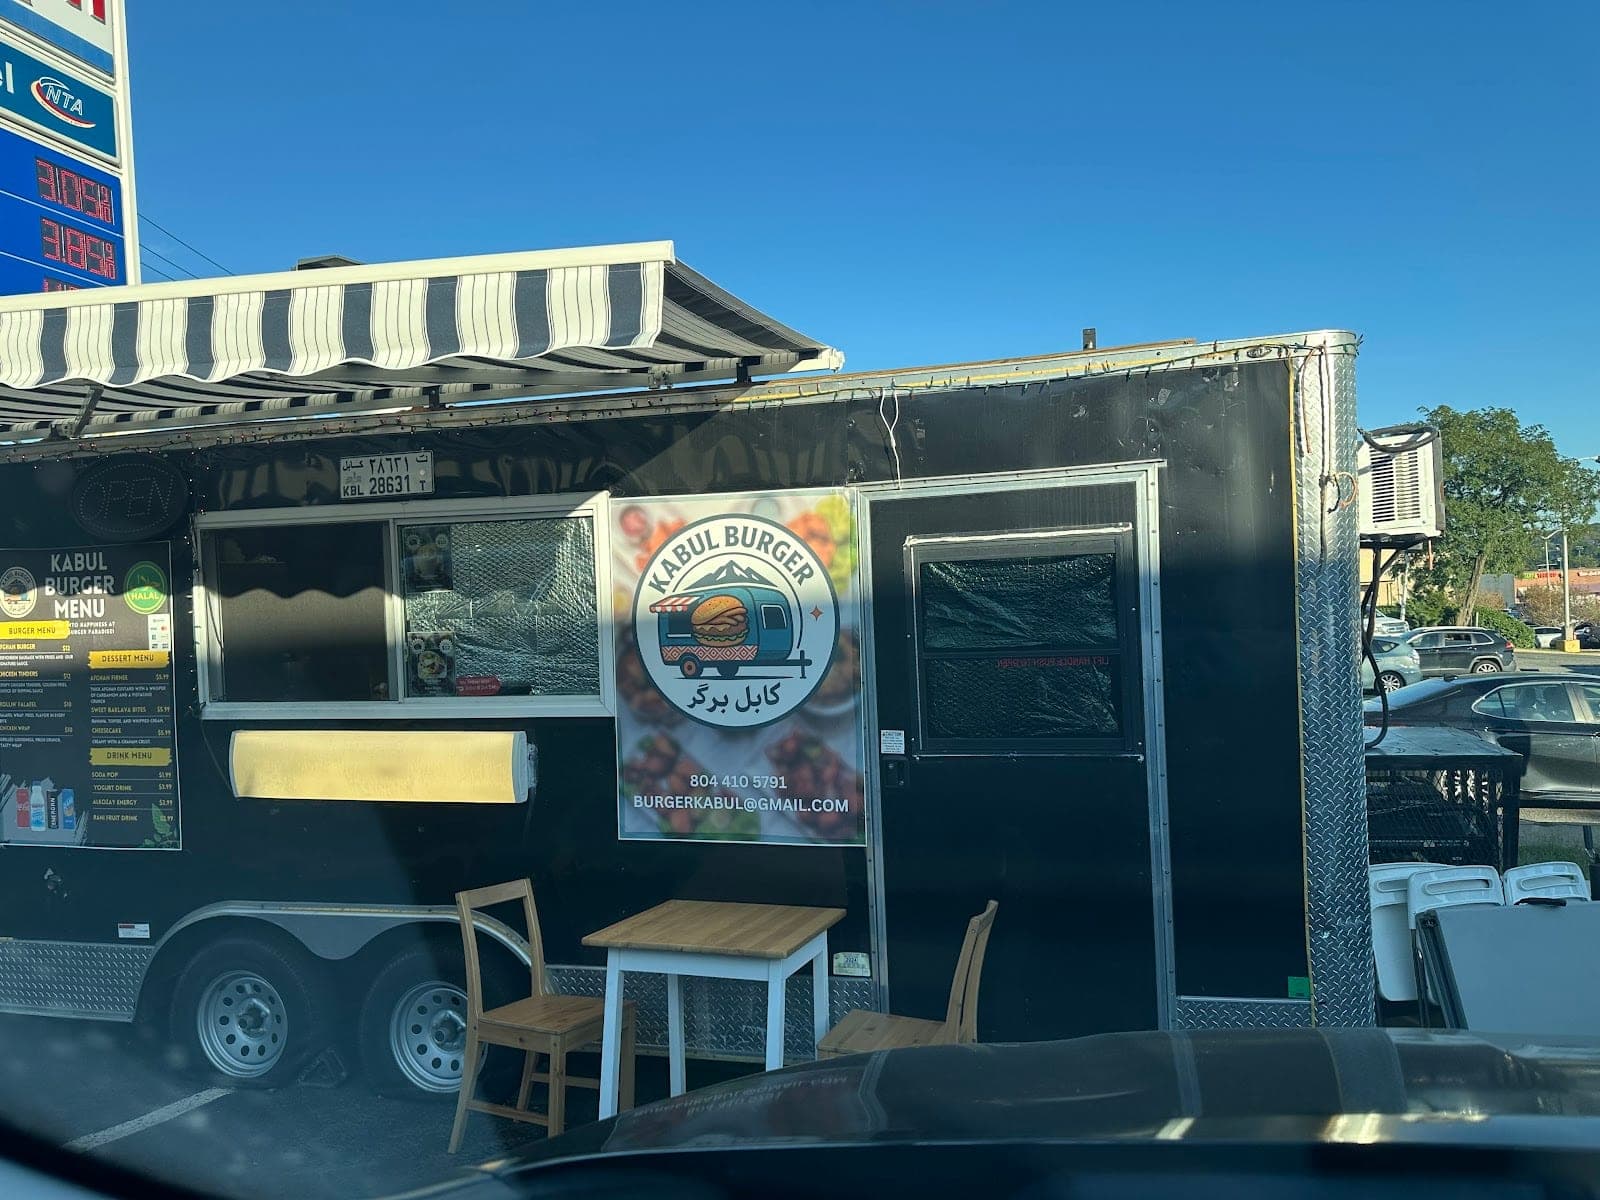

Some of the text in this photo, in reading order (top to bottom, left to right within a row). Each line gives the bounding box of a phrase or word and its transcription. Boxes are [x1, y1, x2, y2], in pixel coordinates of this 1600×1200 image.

[46, 85, 84, 116] NTA
[343, 485, 364, 497] KBL
[369, 474, 410, 495] 28631
[420, 480, 426, 491] T
[51, 552, 107, 572] KABUL
[648, 525, 814, 594] KABUL BURGER
[45, 575, 115, 596] BURGER
[131, 592, 159, 601] HALAL
[54, 598, 105, 619] MENU
[9, 626, 56, 635] BURGER MENU
[102, 654, 154, 662] DESSERT MENU
[687, 682, 781, 714] کابل برگر
[107, 751, 152, 759] DRINK MENU
[689, 774, 788, 789] 804 410 5791
[633, 795, 849, 813] BURGERKABUL@GMAIL.COM
